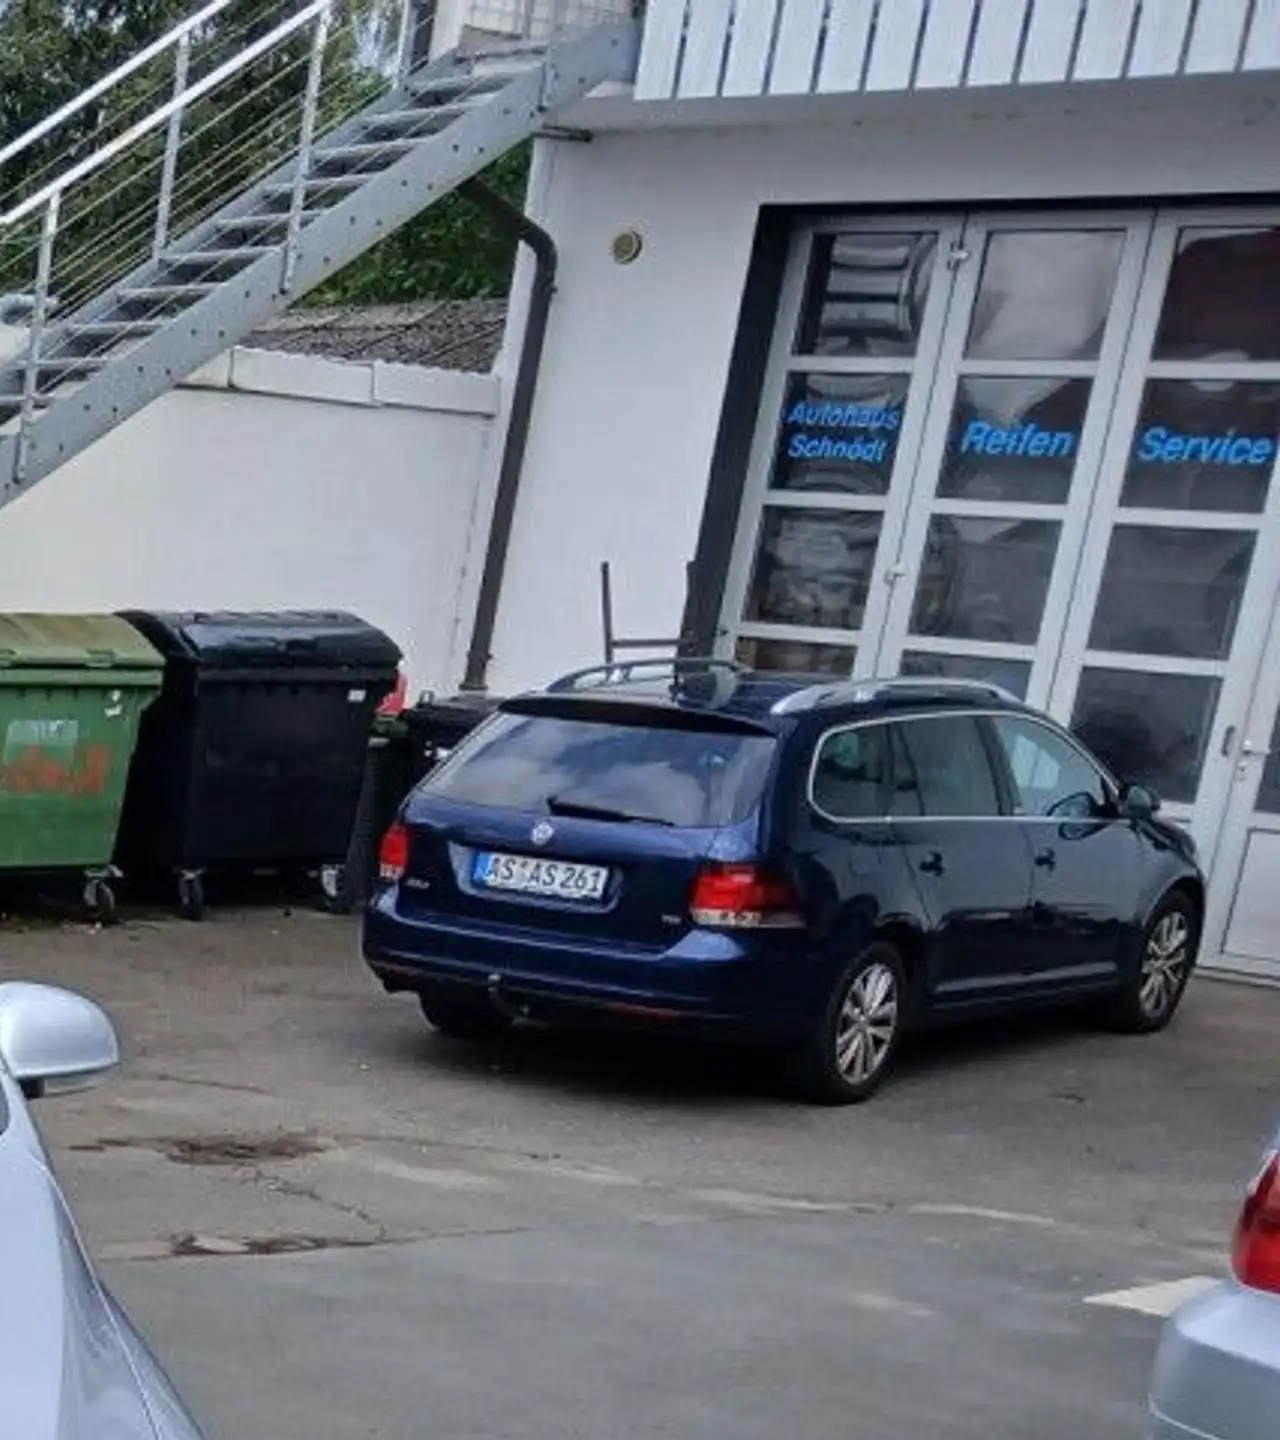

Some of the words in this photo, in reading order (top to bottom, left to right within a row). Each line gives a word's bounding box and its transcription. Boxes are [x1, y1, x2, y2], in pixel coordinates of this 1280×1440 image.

[789, 402, 900, 430] Autohaus
[961, 421, 1074, 456] Reifen
[1140, 426, 1272, 464] Service
